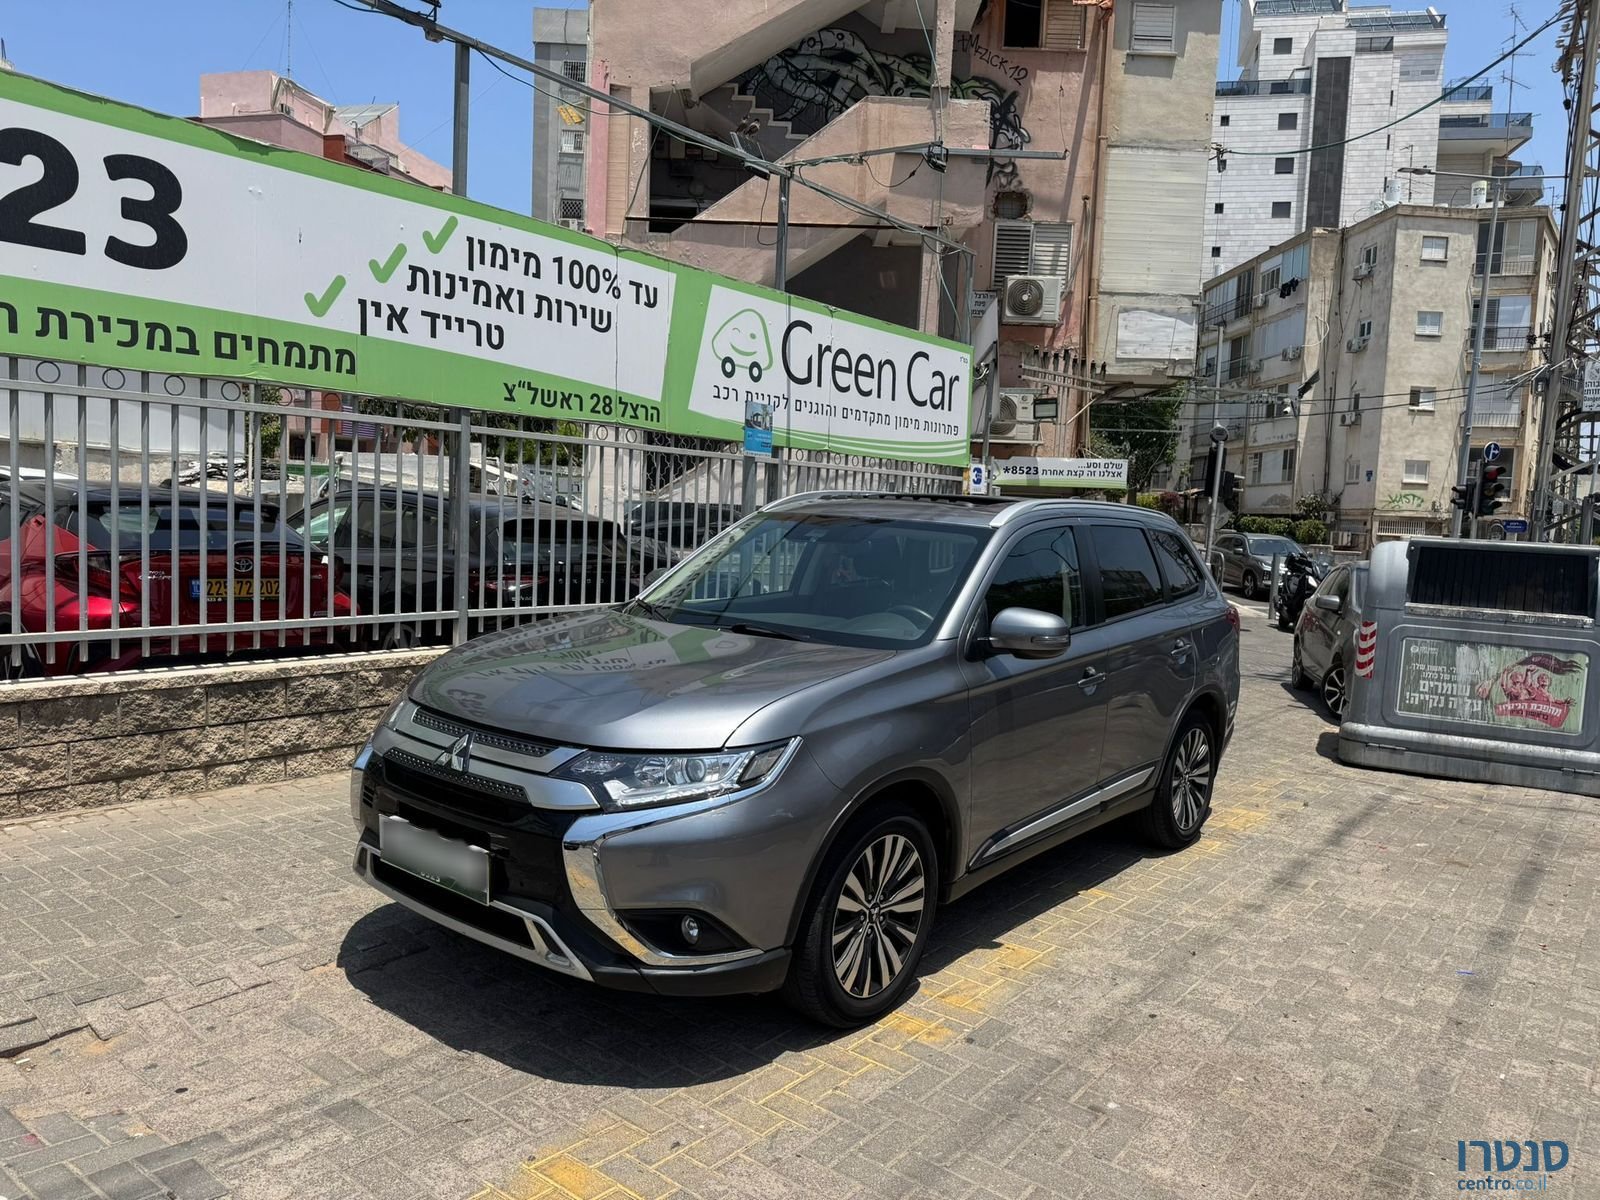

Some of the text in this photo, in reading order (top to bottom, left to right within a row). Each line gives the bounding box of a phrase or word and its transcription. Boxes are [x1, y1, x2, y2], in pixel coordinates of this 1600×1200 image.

[0, 127, 188, 270] 23
[466, 235, 658, 308] עד 100% מימון
[406, 264, 612, 333] שירות ואמינות
[35, 306, 200, 356] במכירת
[357, 297, 505, 351] טרייד אין
[214, 331, 356, 376] מתמחים
[781, 319, 960, 412] Green Car
[712, 384, 739, 402] רכב
[590, 392, 613, 416] 28
[618, 396, 660, 423] הרצל
[795, 399, 836, 418] והוגנים
[842, 407, 891, 426] מתקדמים
[894, 415, 920, 430] מימון
[923, 420, 959, 436] פתרונות
[1041, 468, 1123, 479] אצלנו זה קצת אחרת
[1103, 461, 1123, 470] שלם
[206, 580, 280, 597] 22572202
[1420, 680, 1471, 696] שומרים
[1405, 692, 1482, 711] עלה נקייה!
